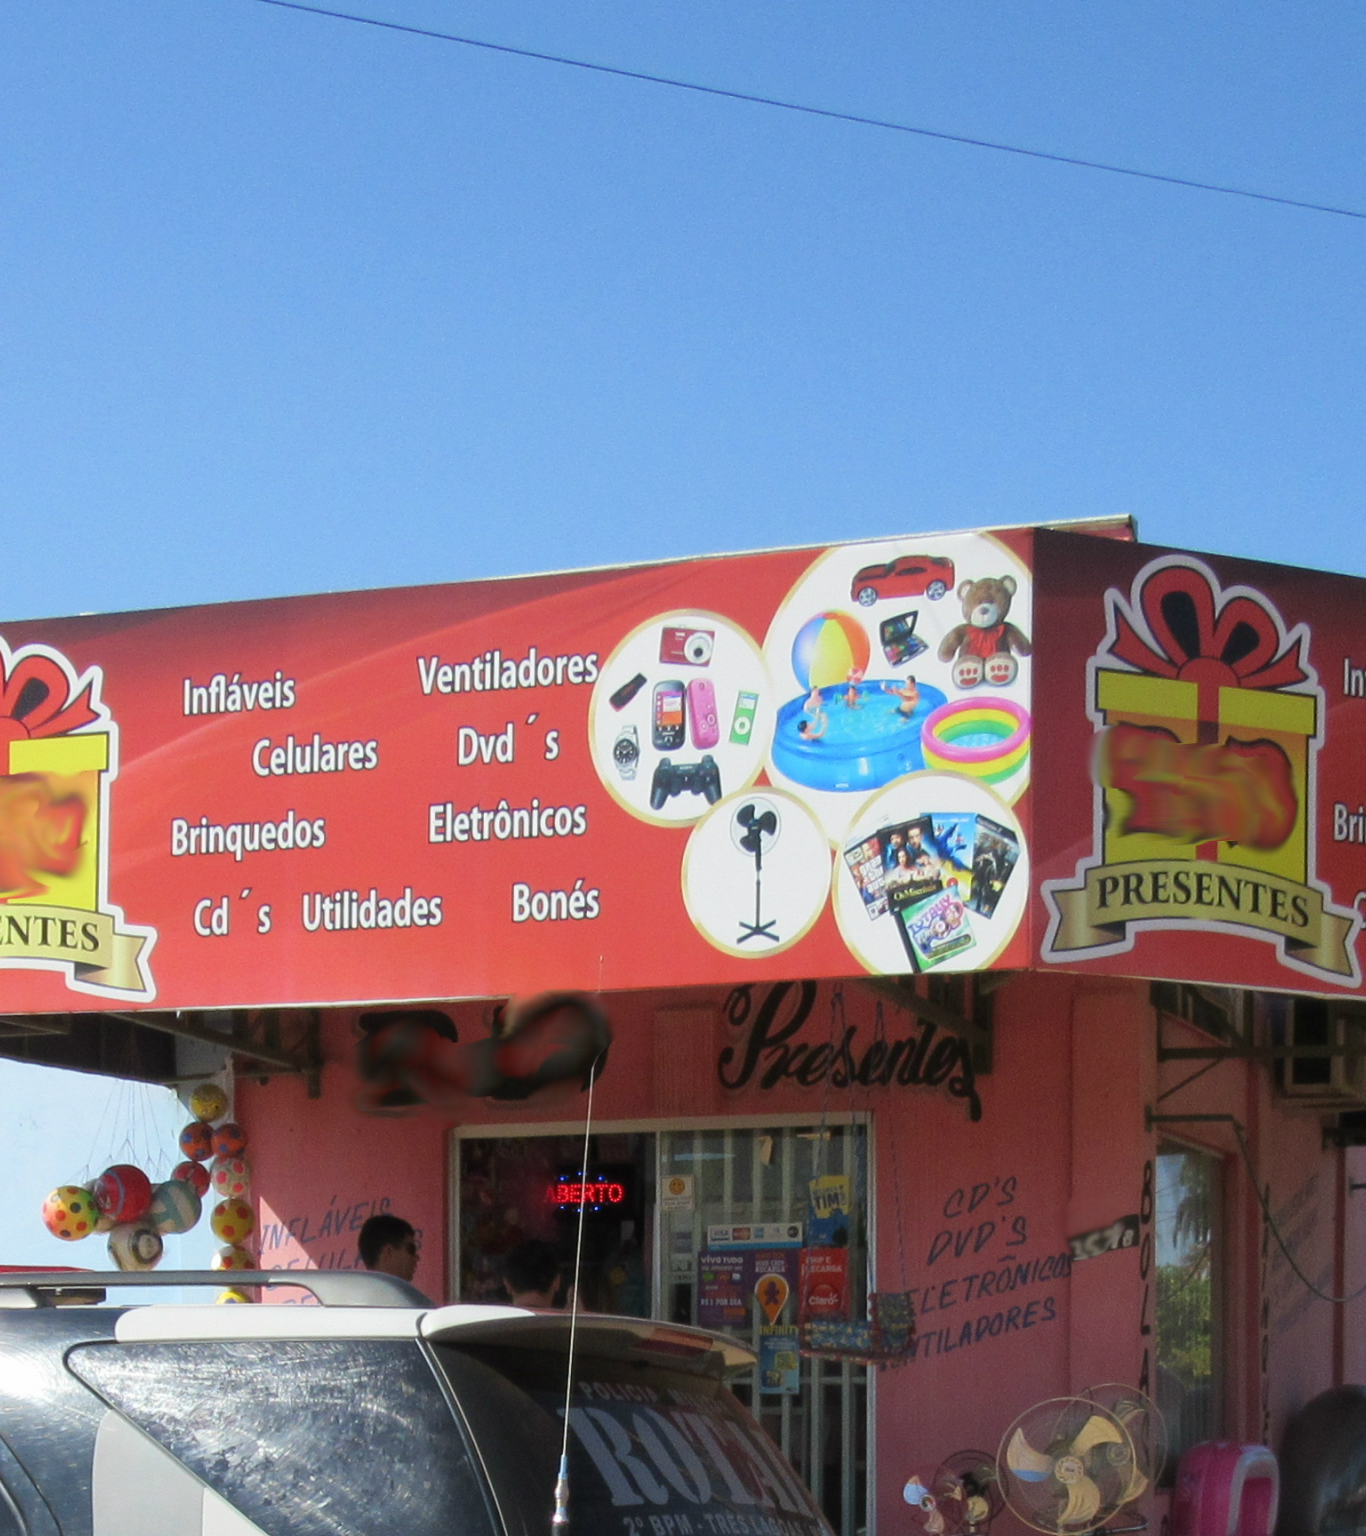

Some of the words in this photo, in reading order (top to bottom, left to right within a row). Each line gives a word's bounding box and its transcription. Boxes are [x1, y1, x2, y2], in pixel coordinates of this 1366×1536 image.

[184, 671, 295, 716] Infláveis
[418, 649, 599, 696] Ventiladores
[252, 734, 378, 777] Celulares
[172, 811, 325, 861] Brinquedos
[429, 802, 587, 843] Eletrônicos
[303, 888, 442, 932] Utilidades
[513, 879, 600, 922] Bonés
[1096, 871, 1310, 928] PRESENTES
[544, 1182, 624, 1204] ABERTO
[943, 1177, 1017, 1219] CD'S
[927, 1216, 1027, 1266] DVD'S
[648, 1513, 695, 1536] BPM
